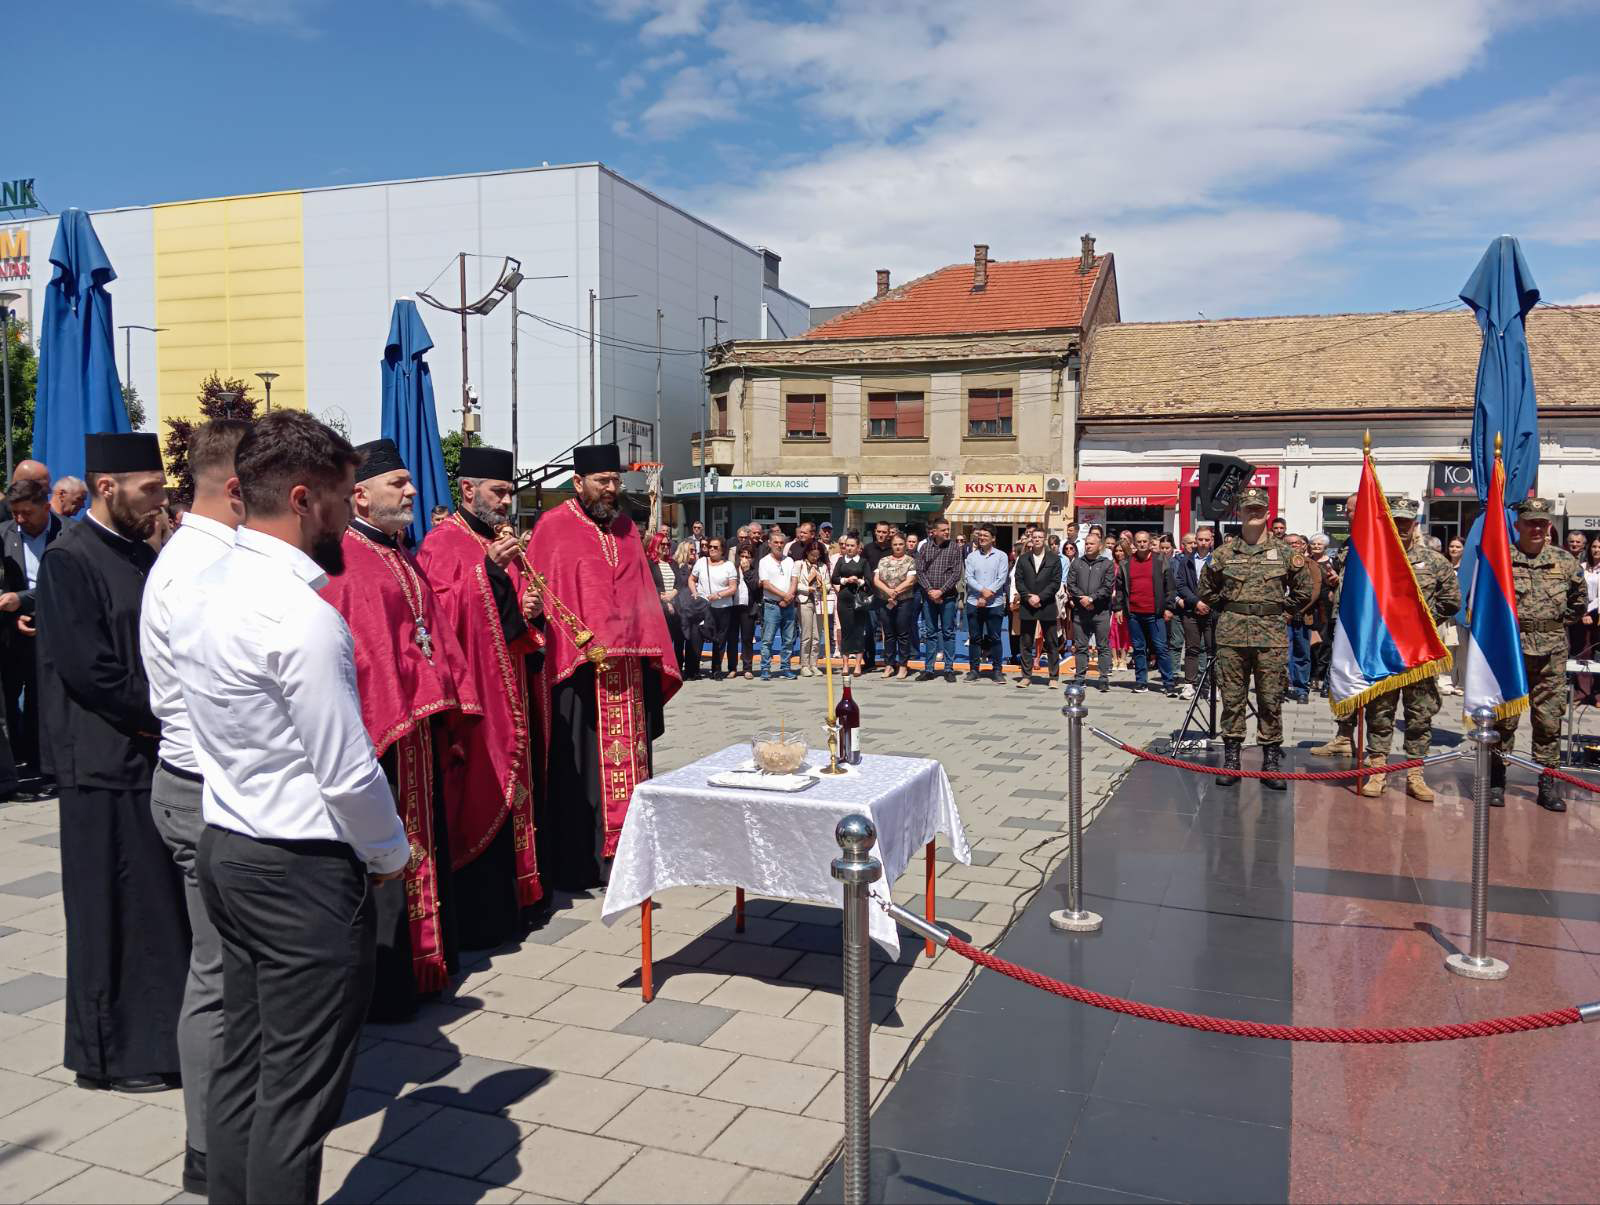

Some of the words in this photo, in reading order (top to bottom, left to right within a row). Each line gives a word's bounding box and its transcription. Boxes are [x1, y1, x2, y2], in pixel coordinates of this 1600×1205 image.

[0, 178, 36, 206] NK
[745, 480, 782, 488] APOTEKA
[865, 502, 921, 511] PARFIMERIJA
